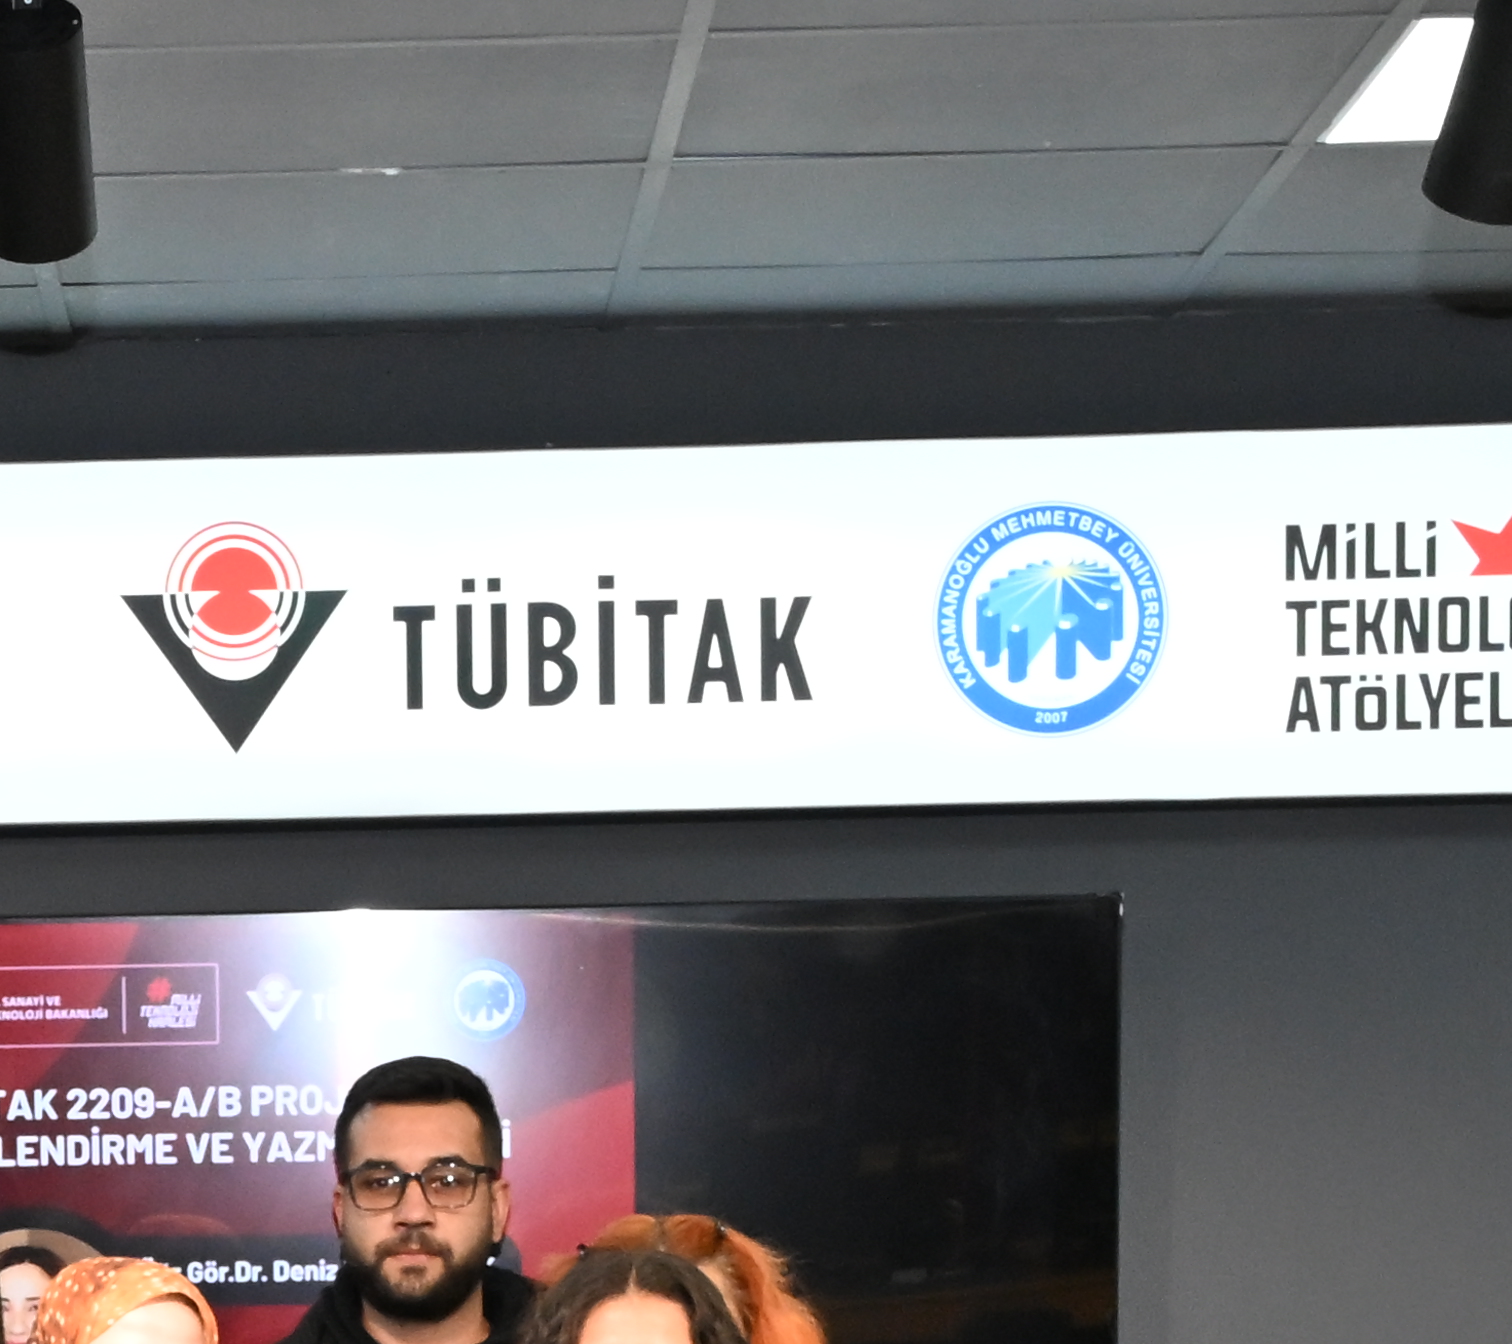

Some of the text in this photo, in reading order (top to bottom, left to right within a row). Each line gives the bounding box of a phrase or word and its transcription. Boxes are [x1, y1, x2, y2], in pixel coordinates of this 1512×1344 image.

[940, 536, 990, 690] KARAMANOĞLU
[990, 509, 1120, 543] MEHMETBEY
[392, 574, 814, 710] TÜBİTAK
[1034, 710, 1069, 725] 2007
[44, 995, 62, 1007] VE
[66, 1085, 243, 1121] 2209-A/B
[250, 1083, 345, 1117] PROJ
[185, 1131, 235, 1165] VE
[241, 1130, 336, 1164] YAZM
[272, 1258, 339, 1283] Deniz
